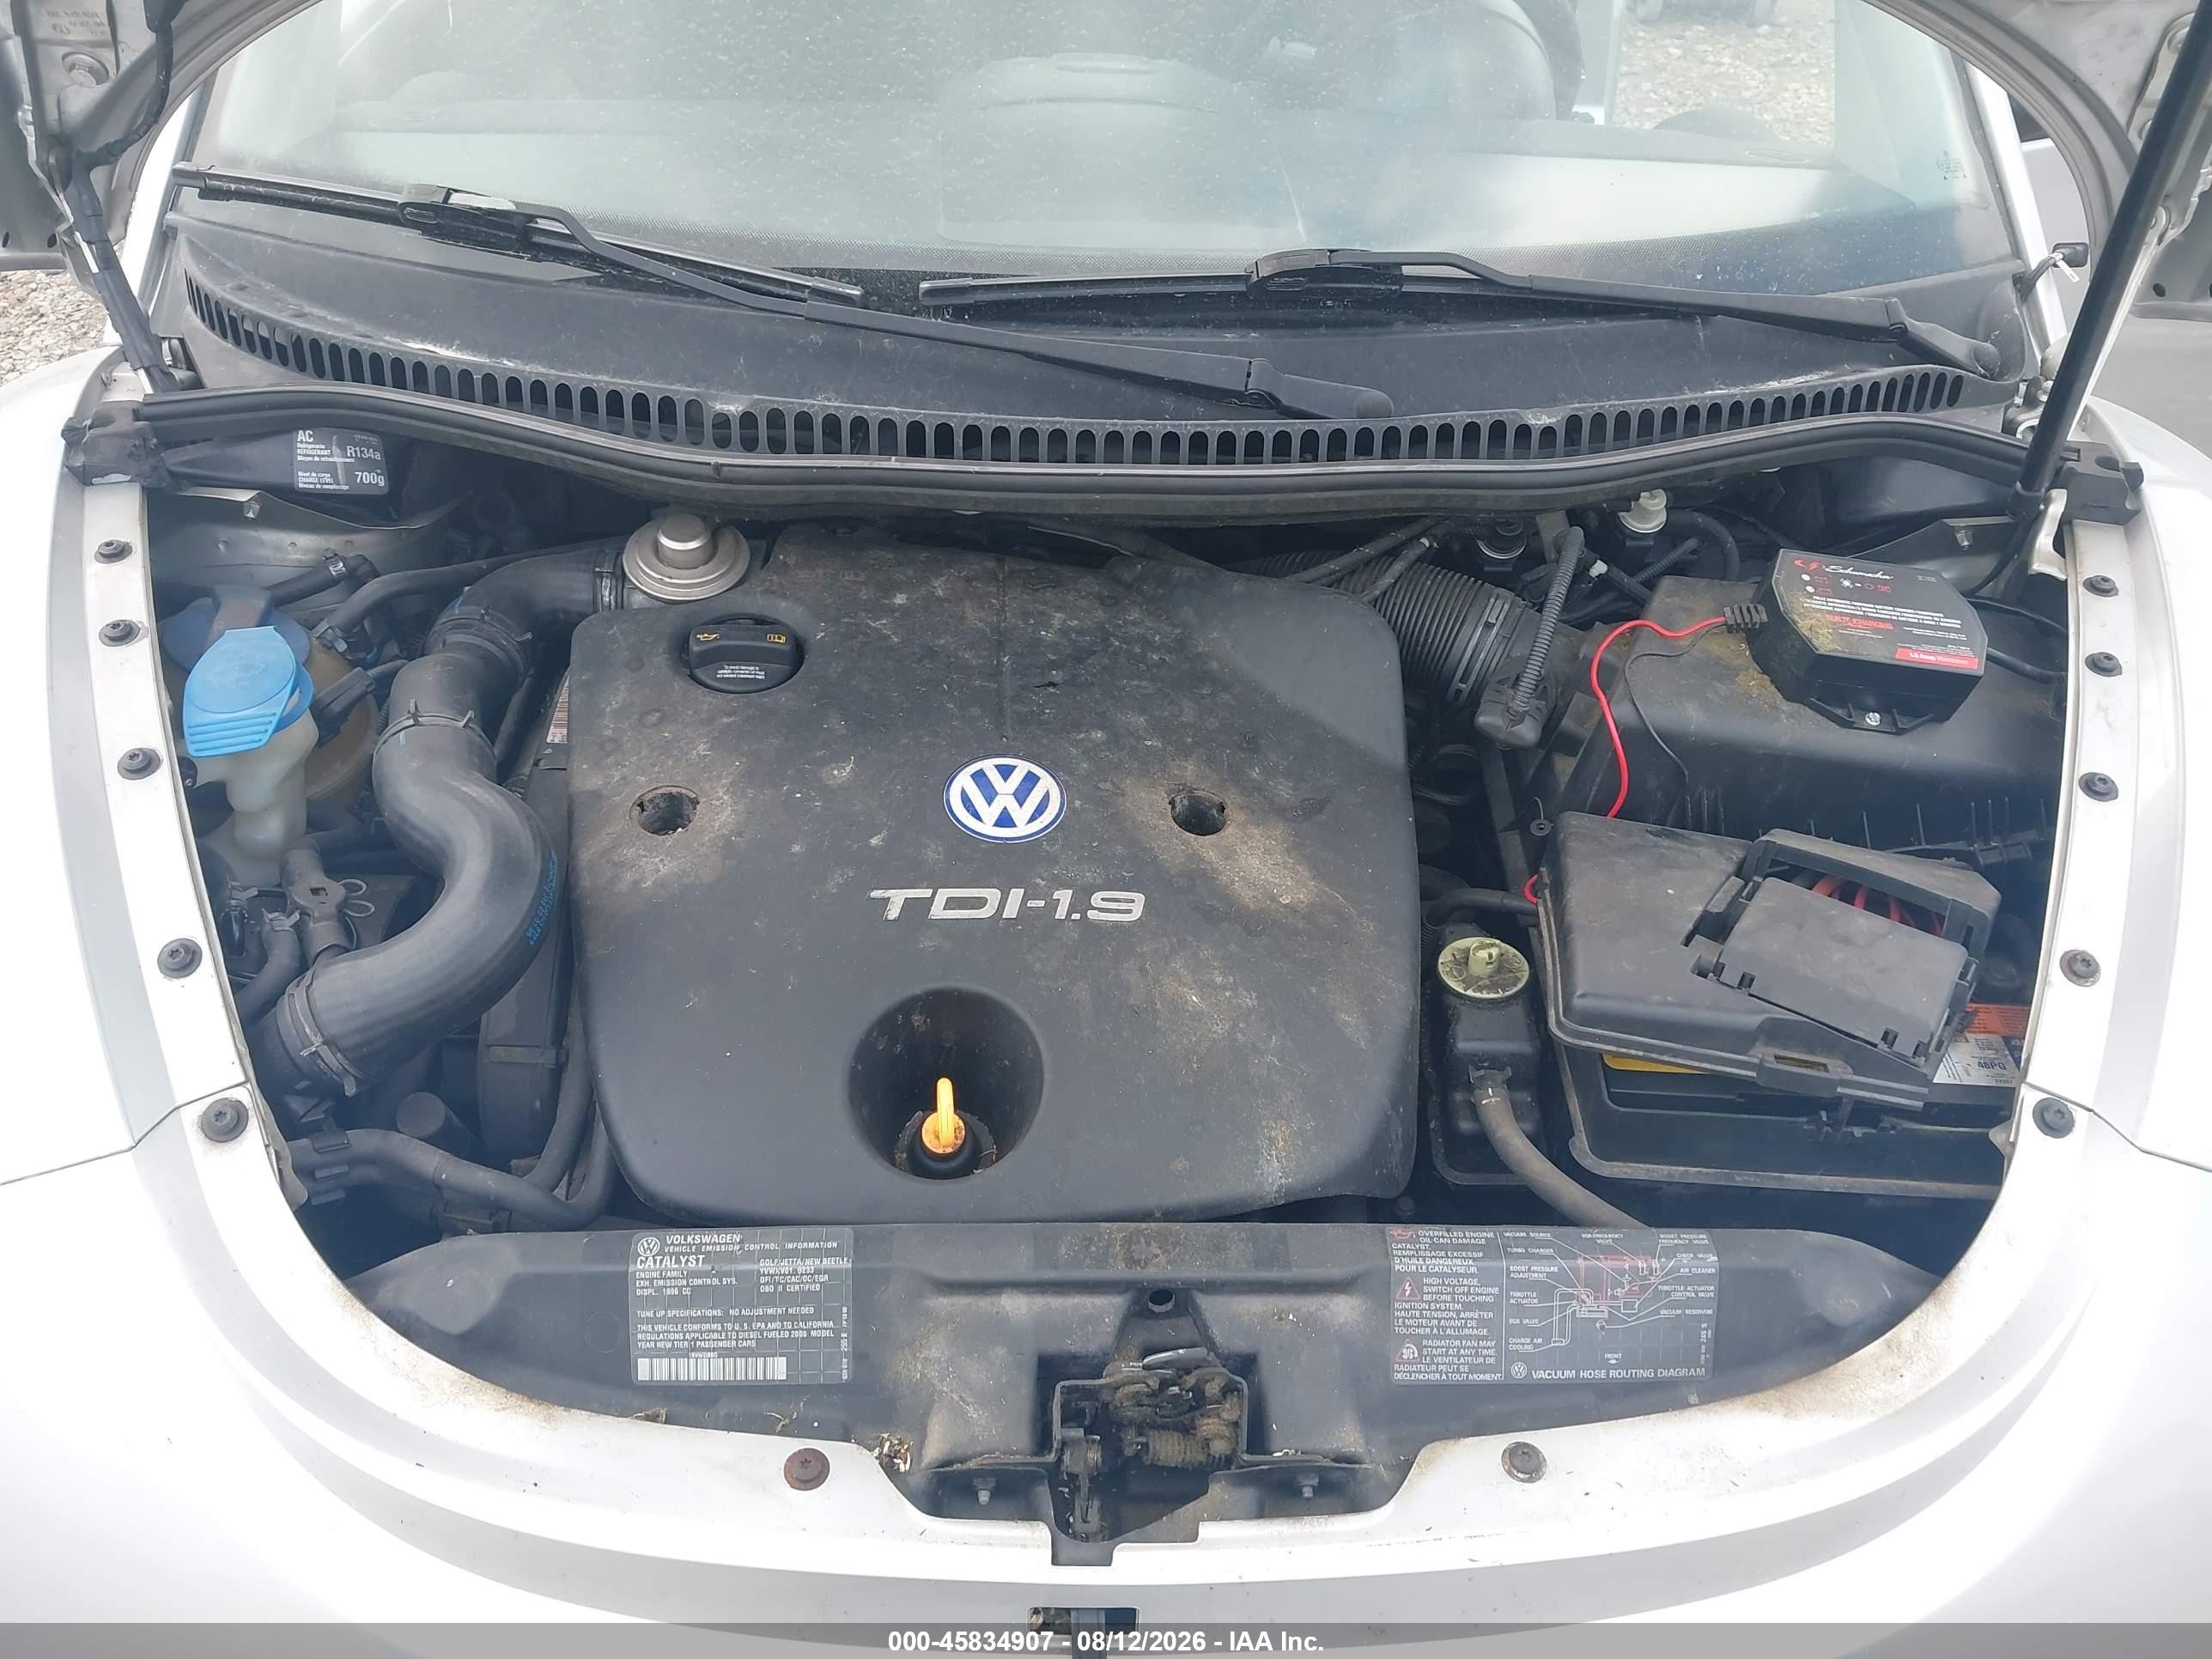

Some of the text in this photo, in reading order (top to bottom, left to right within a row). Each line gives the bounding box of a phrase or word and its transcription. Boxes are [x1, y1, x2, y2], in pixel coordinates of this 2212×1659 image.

[297, 430, 313, 442] AC
[347, 446, 381, 460] R134a
[355, 471, 385, 487] 700g
[943, 754, 1066, 843] VW
[868, 888, 1146, 922] TDI-1.9
[666, 1234, 740, 1244] VOLKSWAGEN
[637, 1255, 705, 1269] CATALYST
[689, 1278, 720, 1286] CONTROL
[1443, 1278, 1480, 1286] VOLTAGE,
[1470, 1286, 1499, 1295] ENGINE
[742, 1307, 786, 1316] ADJUSTMENT
[1422, 1310, 1458, 1319] TENSION,
[1460, 1309, 1494, 1319] ARRÊTER
[811, 1329, 835, 1338] MODEL
[696, 1340, 737, 1348] PASSENGER
[1395, 1371, 1439, 1380] DÉCLENCHER
[1532, 1367, 1705, 1379] VACUUM HOSE ROUTING DIAGRAM
